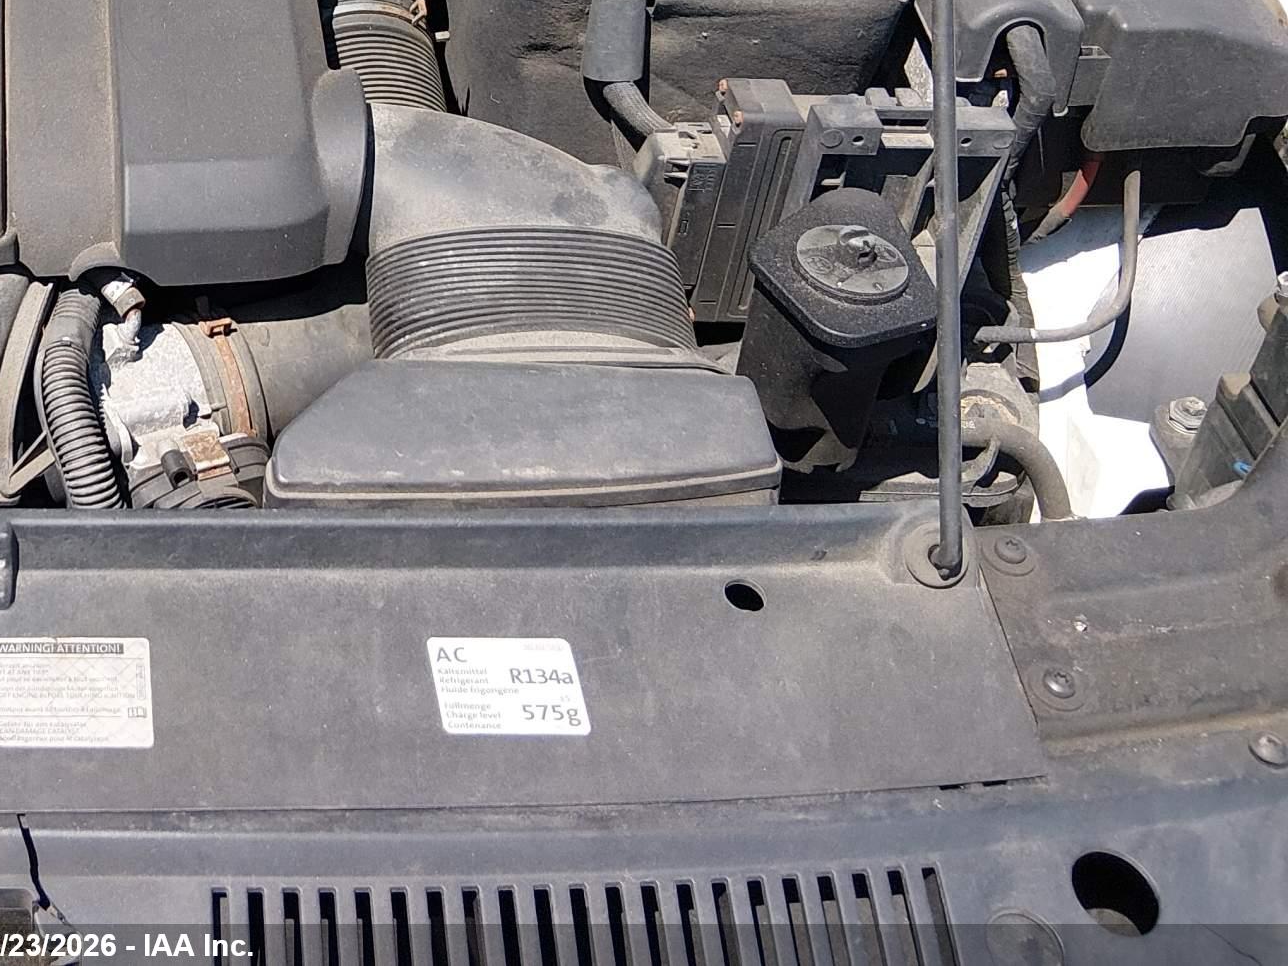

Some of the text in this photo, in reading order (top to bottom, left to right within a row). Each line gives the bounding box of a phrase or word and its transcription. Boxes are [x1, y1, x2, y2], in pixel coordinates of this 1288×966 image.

[57, 643, 122, 652] ATTENTION!
[436, 646, 468, 663] AC
[509, 667, 574, 684] R134a
[521, 704, 582, 728] 575g
